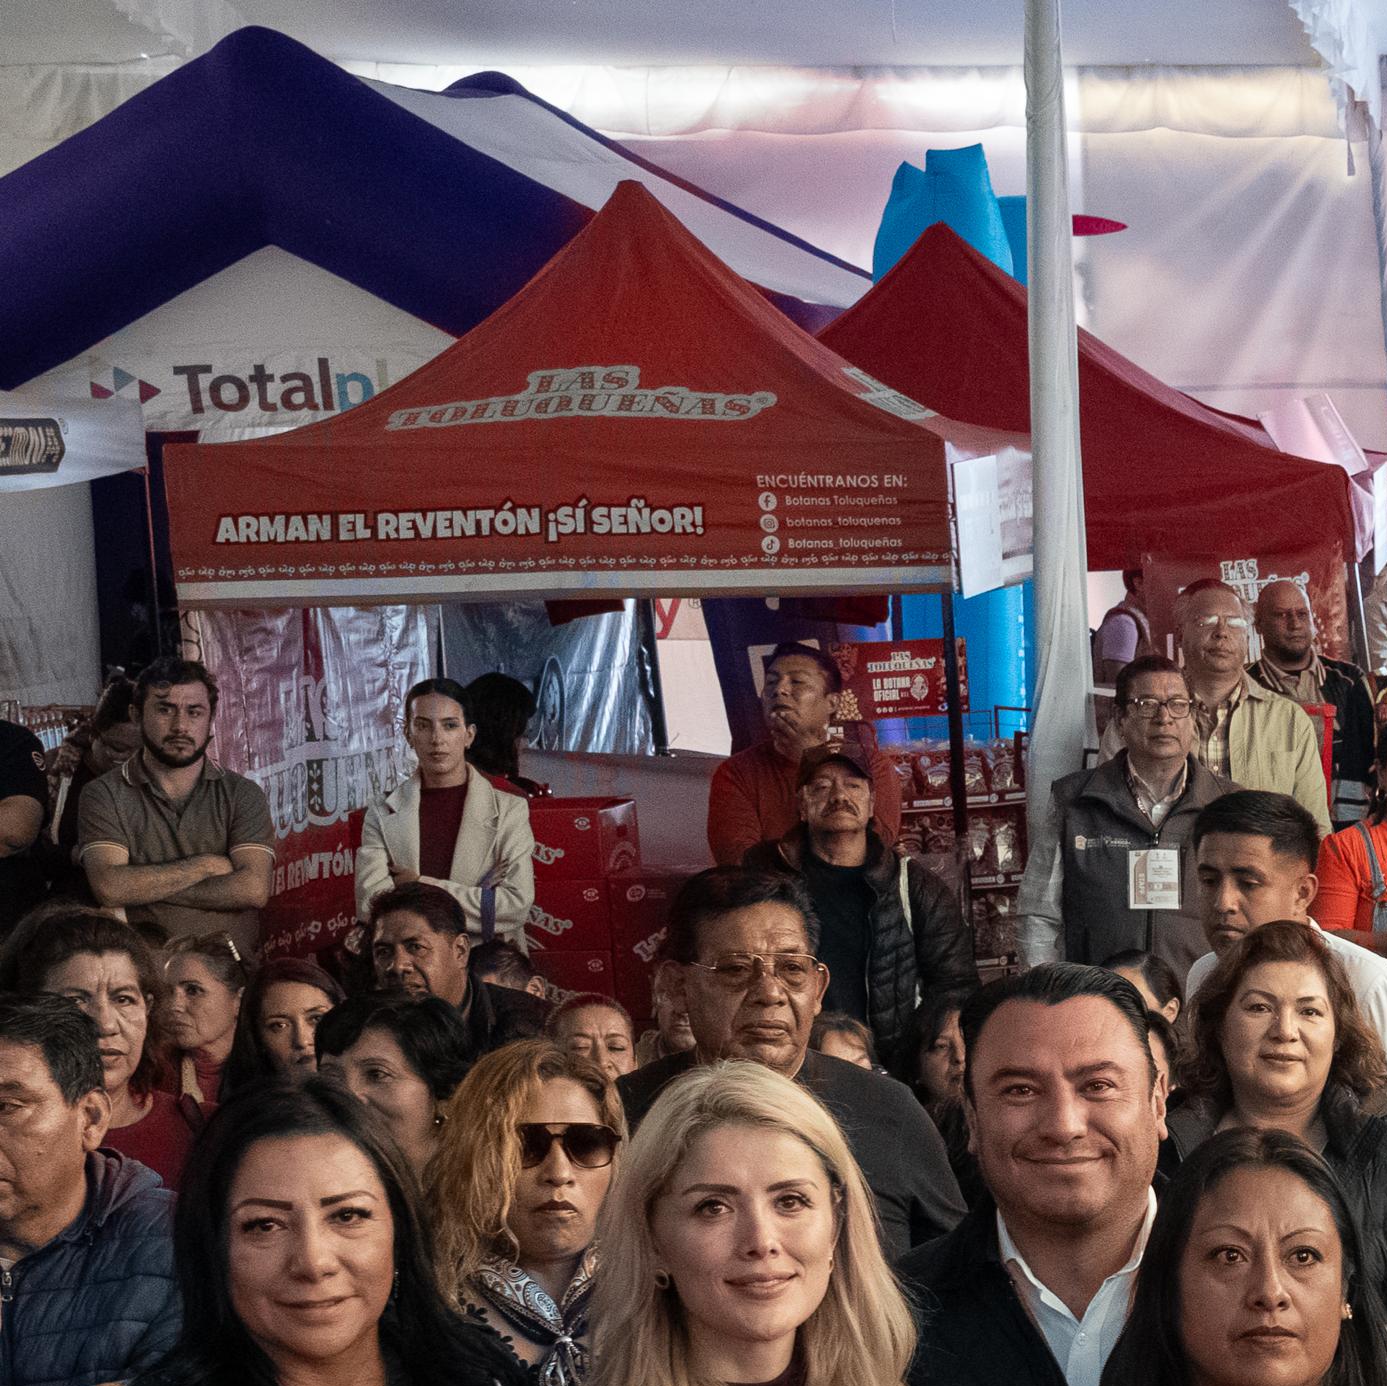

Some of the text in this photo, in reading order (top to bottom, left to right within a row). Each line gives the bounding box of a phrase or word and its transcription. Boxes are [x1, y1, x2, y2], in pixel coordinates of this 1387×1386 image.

[533, 367, 632, 394] LAS
[756, 471, 908, 488] ENCUÉNTRANOS EN:
[785, 494, 898, 507] Botanas Toluqueñas
[215, 498, 705, 544] ARMAN EL REVENTÓN ¡SÍ SEÑOR!
[1221, 560, 1258, 581] LAS
